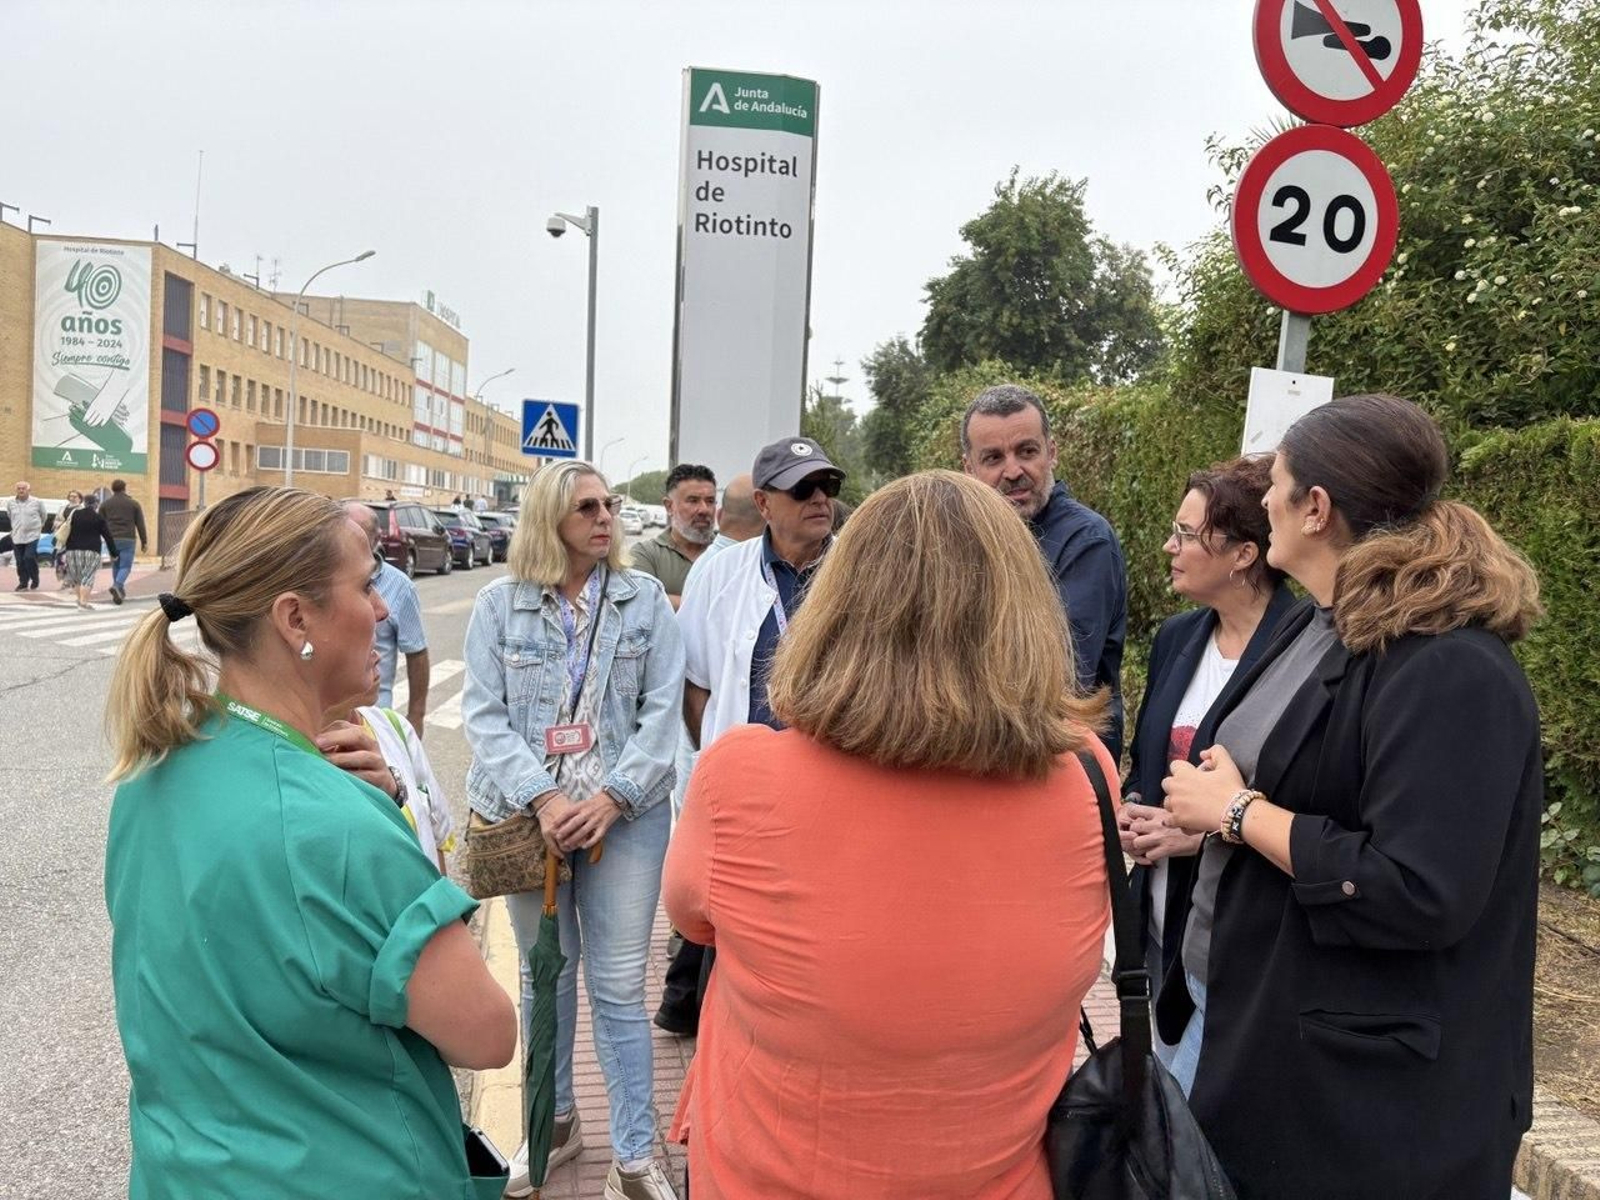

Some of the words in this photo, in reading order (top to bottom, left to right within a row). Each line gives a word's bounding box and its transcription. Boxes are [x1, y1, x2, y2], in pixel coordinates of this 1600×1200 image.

[734, 86, 769, 99] Junta
[734, 100, 750, 111] de
[751, 101, 808, 119] Andalucía
[697, 150, 798, 178] Hospital
[695, 180, 725, 202] de
[694, 212, 792, 239] Riotinto
[1269, 184, 1366, 254] 20
[64, 258, 122, 310] 40
[60, 310, 122, 335] años
[61, 336, 85, 347] 1984
[97, 338, 123, 349] 2024
[51, 350, 93, 367] Siempre
[96, 353, 131, 367] contigo
[226, 701, 261, 722] SATSE
